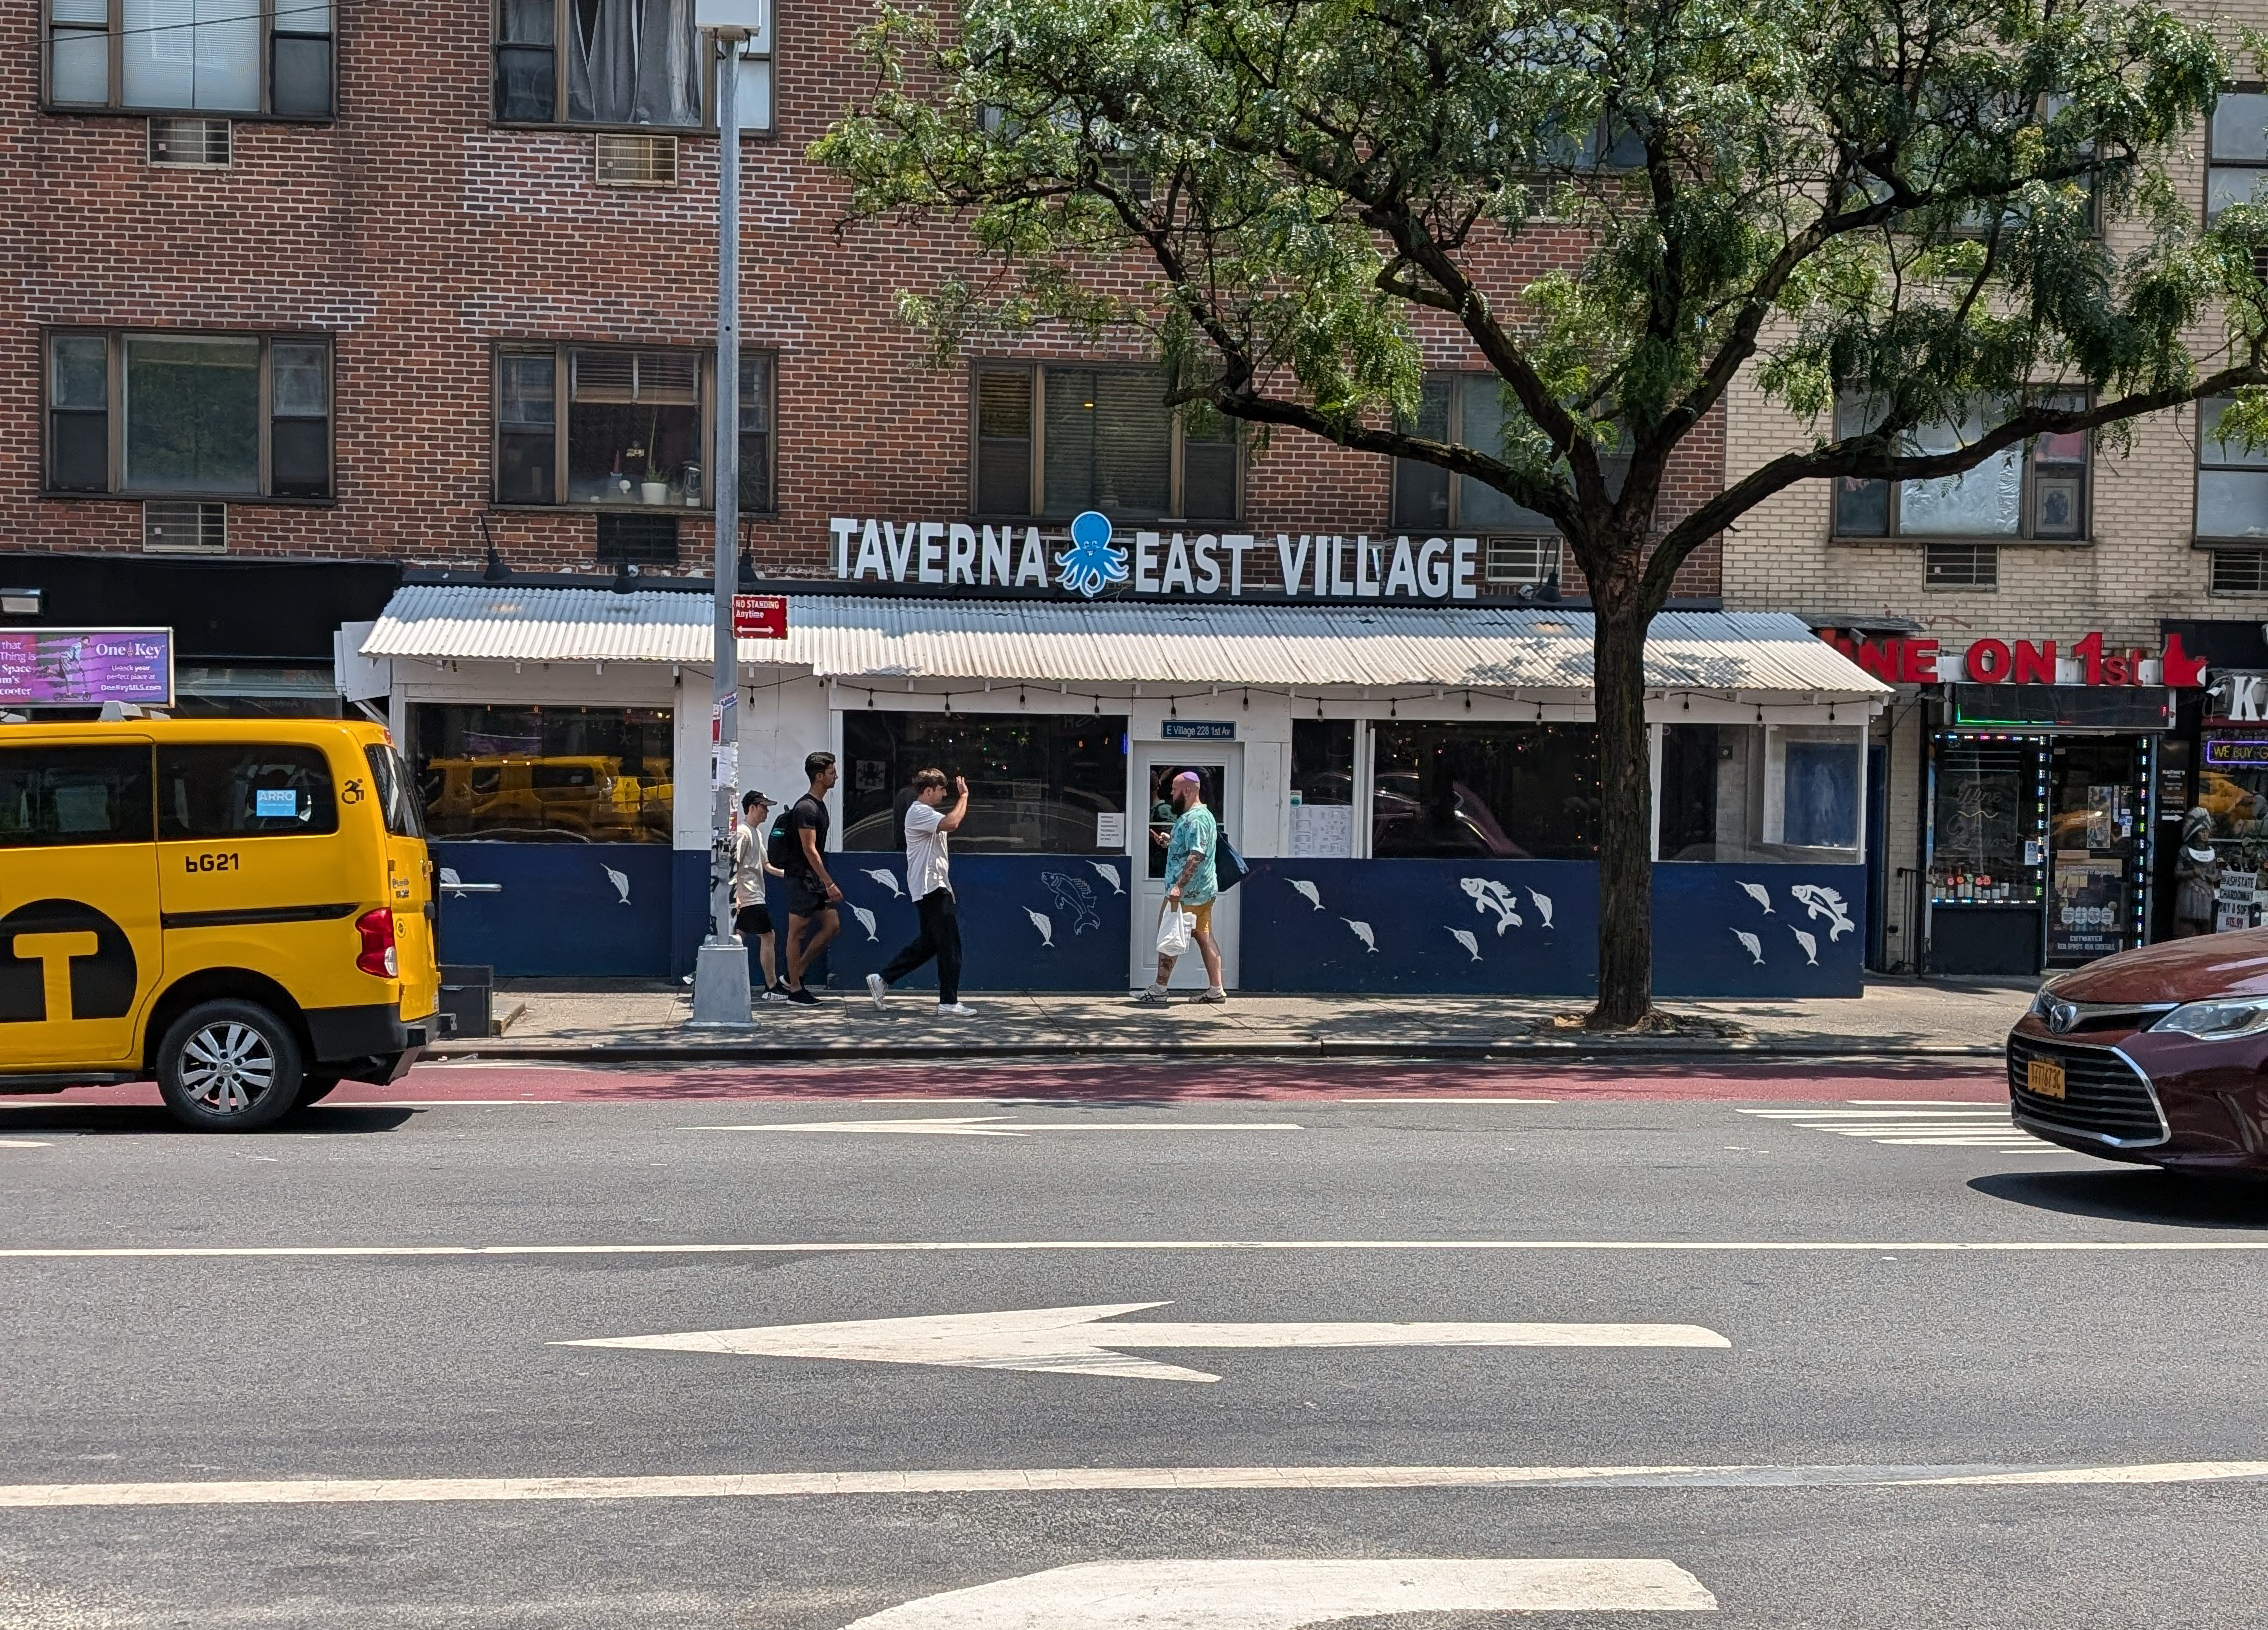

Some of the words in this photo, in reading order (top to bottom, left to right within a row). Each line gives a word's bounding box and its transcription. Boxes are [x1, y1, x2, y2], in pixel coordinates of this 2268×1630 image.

[830, 517, 1049, 588] TAVERNA
[1135, 532, 1255, 596] EAST
[1276, 534, 1478, 599] VILLAGE
[735, 600, 746, 608] NO
[746, 600, 780, 609] STANDING
[735, 610, 765, 619] Anytime
[1, 640, 22, 650] that
[95, 643, 127, 656] One
[134, 642, 162, 657] Key
[27, 651, 37, 661] is
[1963, 638, 2057, 685] ON
[2071, 631, 2144, 687] 1st
[1, 663, 32, 676] Space
[0, 675, 20, 684] m's
[1166, 725, 1173, 735] E
[1173, 725, 1196, 738] Village
[2213, 745, 2231, 758] WE
[2232, 746, 2254, 758] BUY
[260, 791, 294, 801] ARRO
